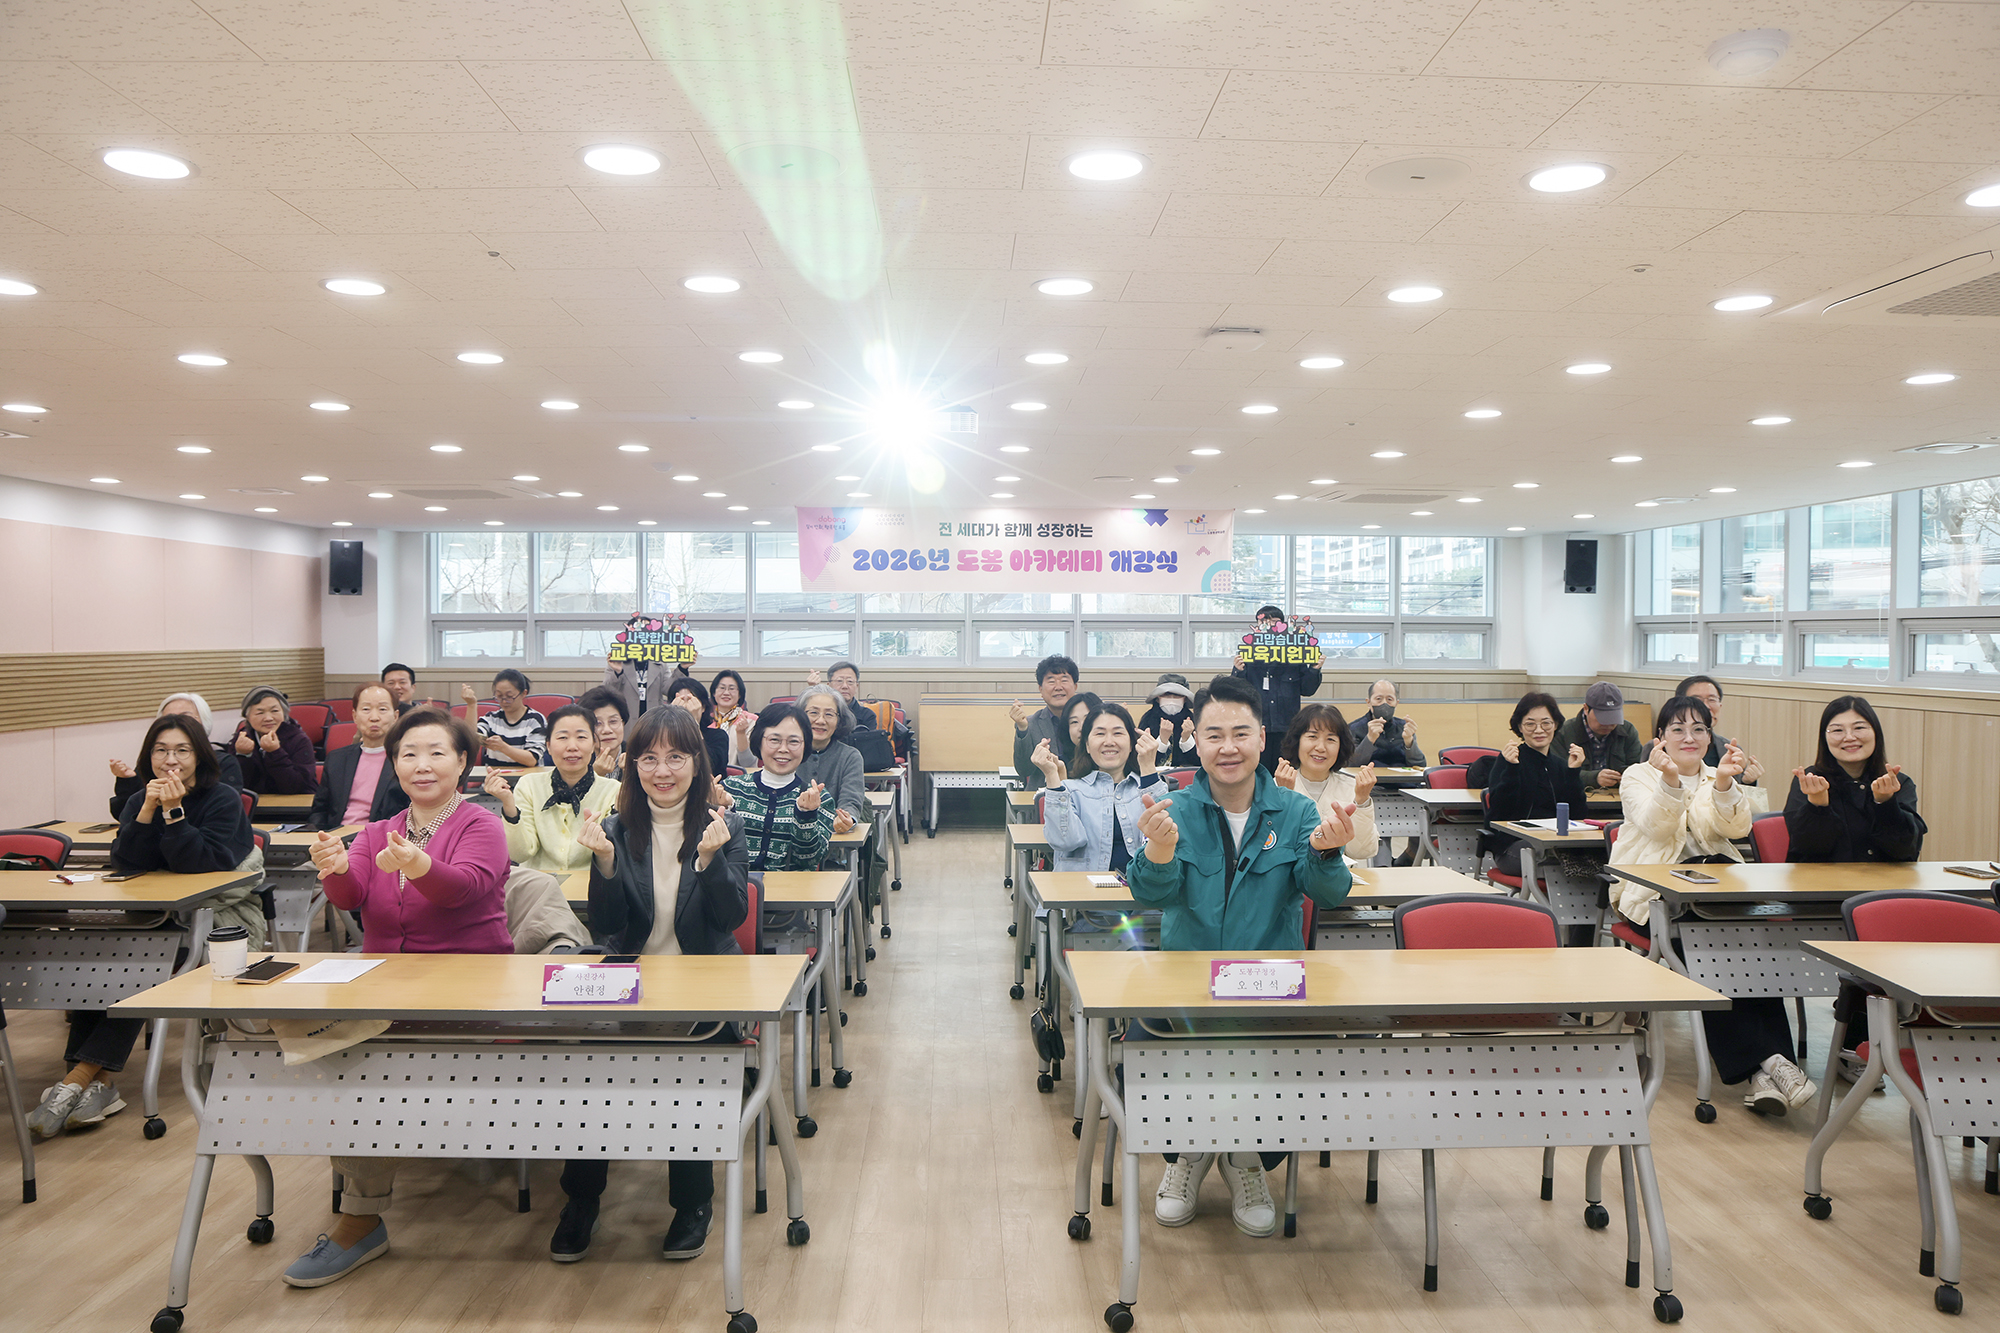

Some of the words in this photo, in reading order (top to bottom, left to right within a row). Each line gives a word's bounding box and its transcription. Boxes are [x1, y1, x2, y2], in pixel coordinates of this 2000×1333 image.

[817, 515, 847, 524] dobong
[939, 522, 952, 537] 전
[957, 522, 1000, 537] 세대가
[1004, 522, 1032, 537] 함께
[1036, 523, 1093, 538] 성장하는
[852, 548, 950, 571] 2026년
[956, 549, 1004, 572] 도봉
[1010, 549, 1103, 573] 아카데미
[1109, 550, 1178, 573] 개강식
[626, 632, 685, 644] 사랑합니다
[1253, 634, 1310, 646] 고맙습니다
[610, 643, 696, 662] 교육지원과
[1238, 645, 1321, 663] 교육지원과
[575, 973, 605, 981] 사진강사
[1239, 968, 1276, 976] 도봉구청장
[573, 985, 605, 996] 안현정
